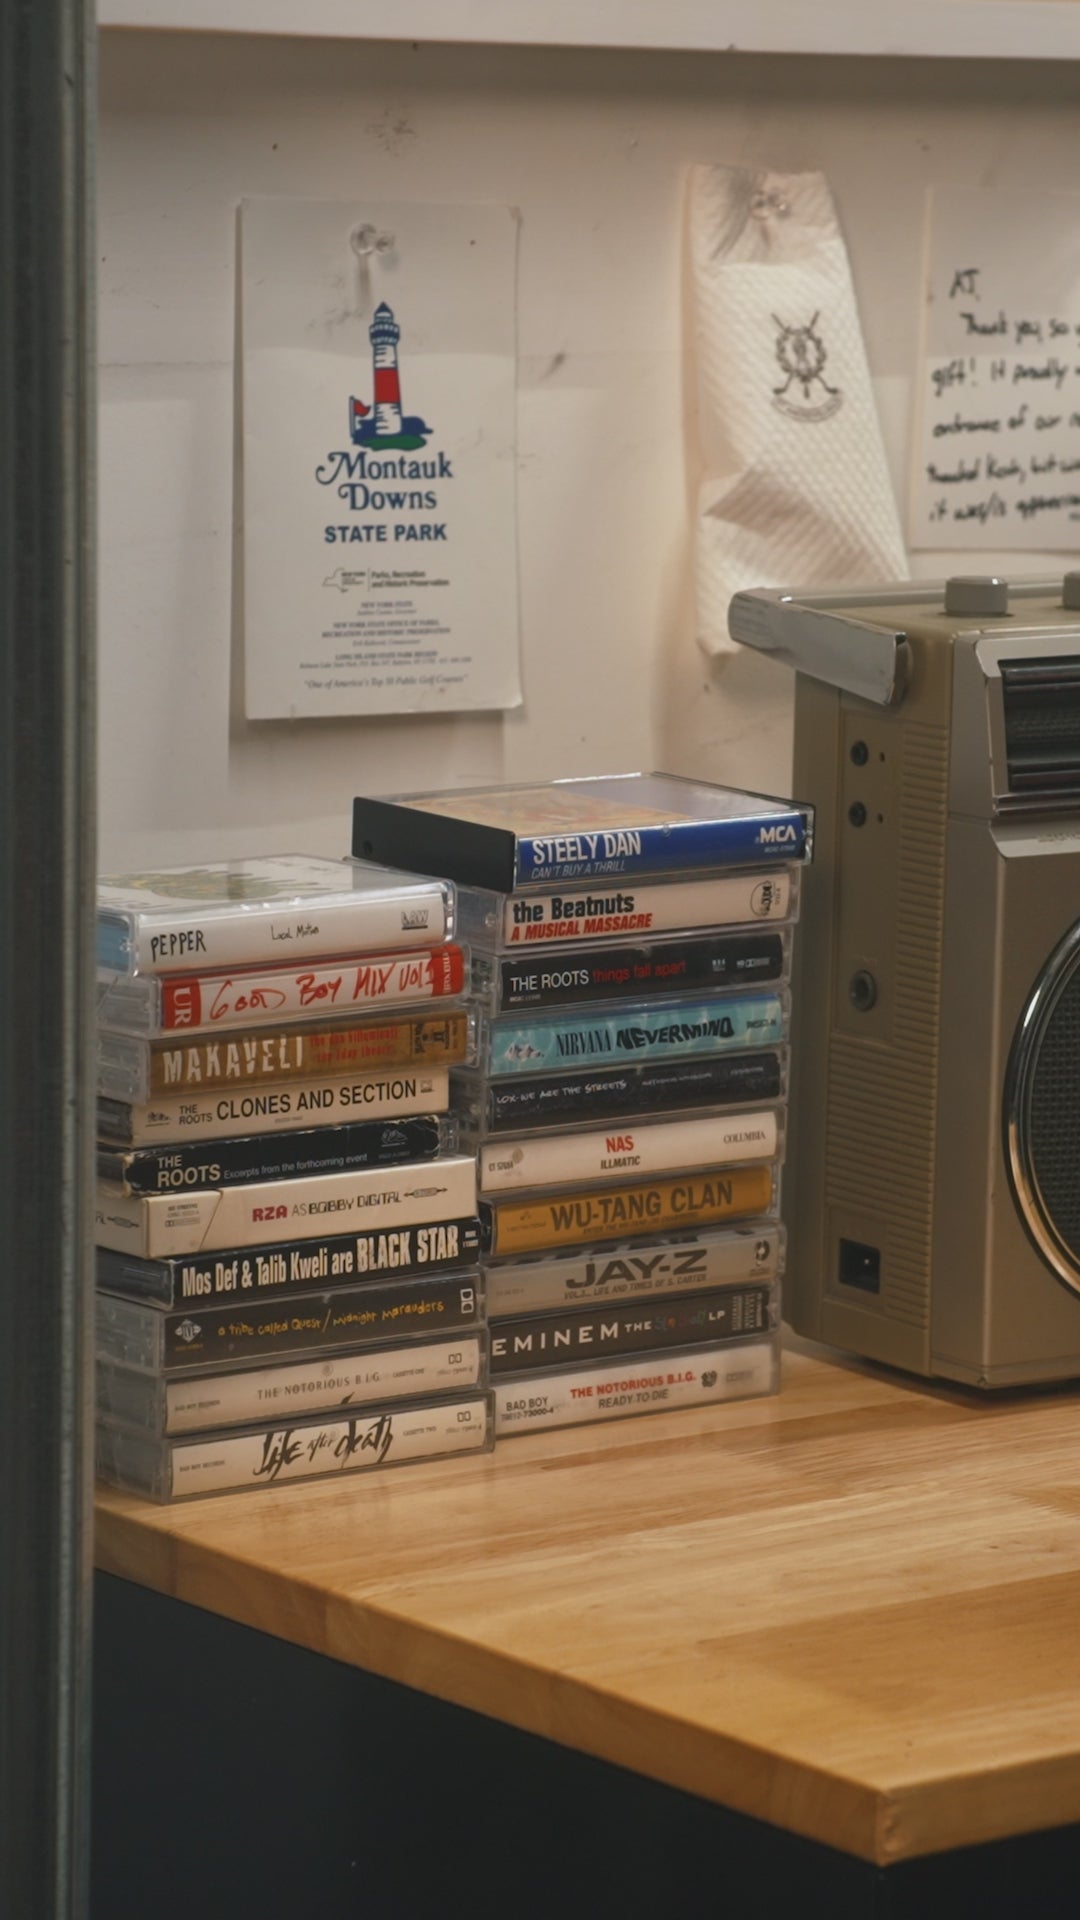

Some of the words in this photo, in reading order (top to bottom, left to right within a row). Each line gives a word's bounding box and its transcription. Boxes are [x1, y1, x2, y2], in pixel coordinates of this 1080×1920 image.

[315, 451, 452, 485] Montauk
[338, 482, 437, 510] Downs
[324, 525, 387, 543] STATE
[395, 523, 447, 542] PARK
[532, 834, 598, 865] STEELY
[604, 831, 642, 858] DAN
[760, 824, 797, 844] MCA
[531, 866, 562, 879] CAN'T
[562, 864, 583, 877] BUY
[582, 865, 592, 874] A
[592, 860, 626, 874] THRILL
[513, 901, 544, 924] the
[551, 893, 635, 919] Beatnuts
[511, 926, 521, 941] A
[524, 919, 581, 940] MUSICAL
[583, 912, 653, 934] MASSACRE
[151, 930, 206, 963] PEPPER
[353, 962, 397, 1000] MIX
[510, 975, 538, 992] THE
[541, 969, 589, 989] ROOTS
[592, 967, 631, 984] things
[633, 962, 652, 977] fall
[655, 959, 687, 977] apart
[174, 986, 192, 1027] UR
[556, 1028, 612, 1057] NIRVANA
[616, 1017, 735, 1051] NEVERMIND
[162, 1035, 303, 1084] MAKAVELI
[217, 1094, 291, 1121] CLONES
[297, 1089, 334, 1111] AND
[339, 1079, 416, 1107] SECTION
[539, 1088, 560, 1099] ARE
[561, 1085, 581, 1097] THE
[584, 1080, 627, 1094] STREETS
[178, 1113, 213, 1126] ROOTS
[179, 1105, 198, 1115] THE
[605, 1135, 634, 1154] NAS
[723, 1130, 766, 1144] COLUMBIA
[157, 1155, 182, 1169] THE
[157, 1163, 221, 1188] ROOTS
[224, 1164, 260, 1180] Excerpts
[261, 1161, 280, 1174] from
[281, 1159, 295, 1172] the
[296, 1153, 345, 1170] forthcoming
[345, 1153, 368, 1164] event
[600, 1155, 641, 1170] ILLMATIC
[252, 1205, 287, 1222] RZA
[292, 1203, 307, 1217] AS
[308, 1198, 354, 1215] BOBBY
[357, 1191, 402, 1208] DIGITAL
[550, 1191, 661, 1231] WU-TANG
[670, 1180, 733, 1213] CLAN
[182, 1267, 211, 1297] Mos
[215, 1260, 238, 1292] Def
[241, 1260, 252, 1288] &
[256, 1254, 287, 1286] Talib
[290, 1247, 327, 1281] Kweli
[331, 1251, 353, 1275] are
[356, 1231, 411, 1273] BLACK
[416, 1225, 459, 1263] STAR
[565, 1249, 708, 1289] JAY-Z
[593, 1286, 609, 1296] LIFE
[612, 1283, 627, 1293] AND
[630, 1280, 653, 1291] TIMES
[655, 1278, 665, 1288] OF
[677, 1273, 707, 1284] CARTER
[228, 1321, 254, 1336] tribe
[257, 1320, 288, 1335] called
[708, 1310, 725, 1321] LP
[492, 1322, 619, 1356] EMINEM
[625, 1320, 652, 1333] THE
[257, 1388, 279, 1400] THE
[284, 1378, 350, 1396] NOTORIOUS
[570, 1386, 593, 1399] THE
[596, 1376, 663, 1396] NOTORIOUS
[667, 1371, 696, 1385] B.I.G.
[598, 1395, 632, 1409] READY
[635, 1393, 649, 1405] TO
[651, 1389, 669, 1402] DIE
[505, 1400, 527, 1412] BAD
[528, 1397, 548, 1409] BOY
